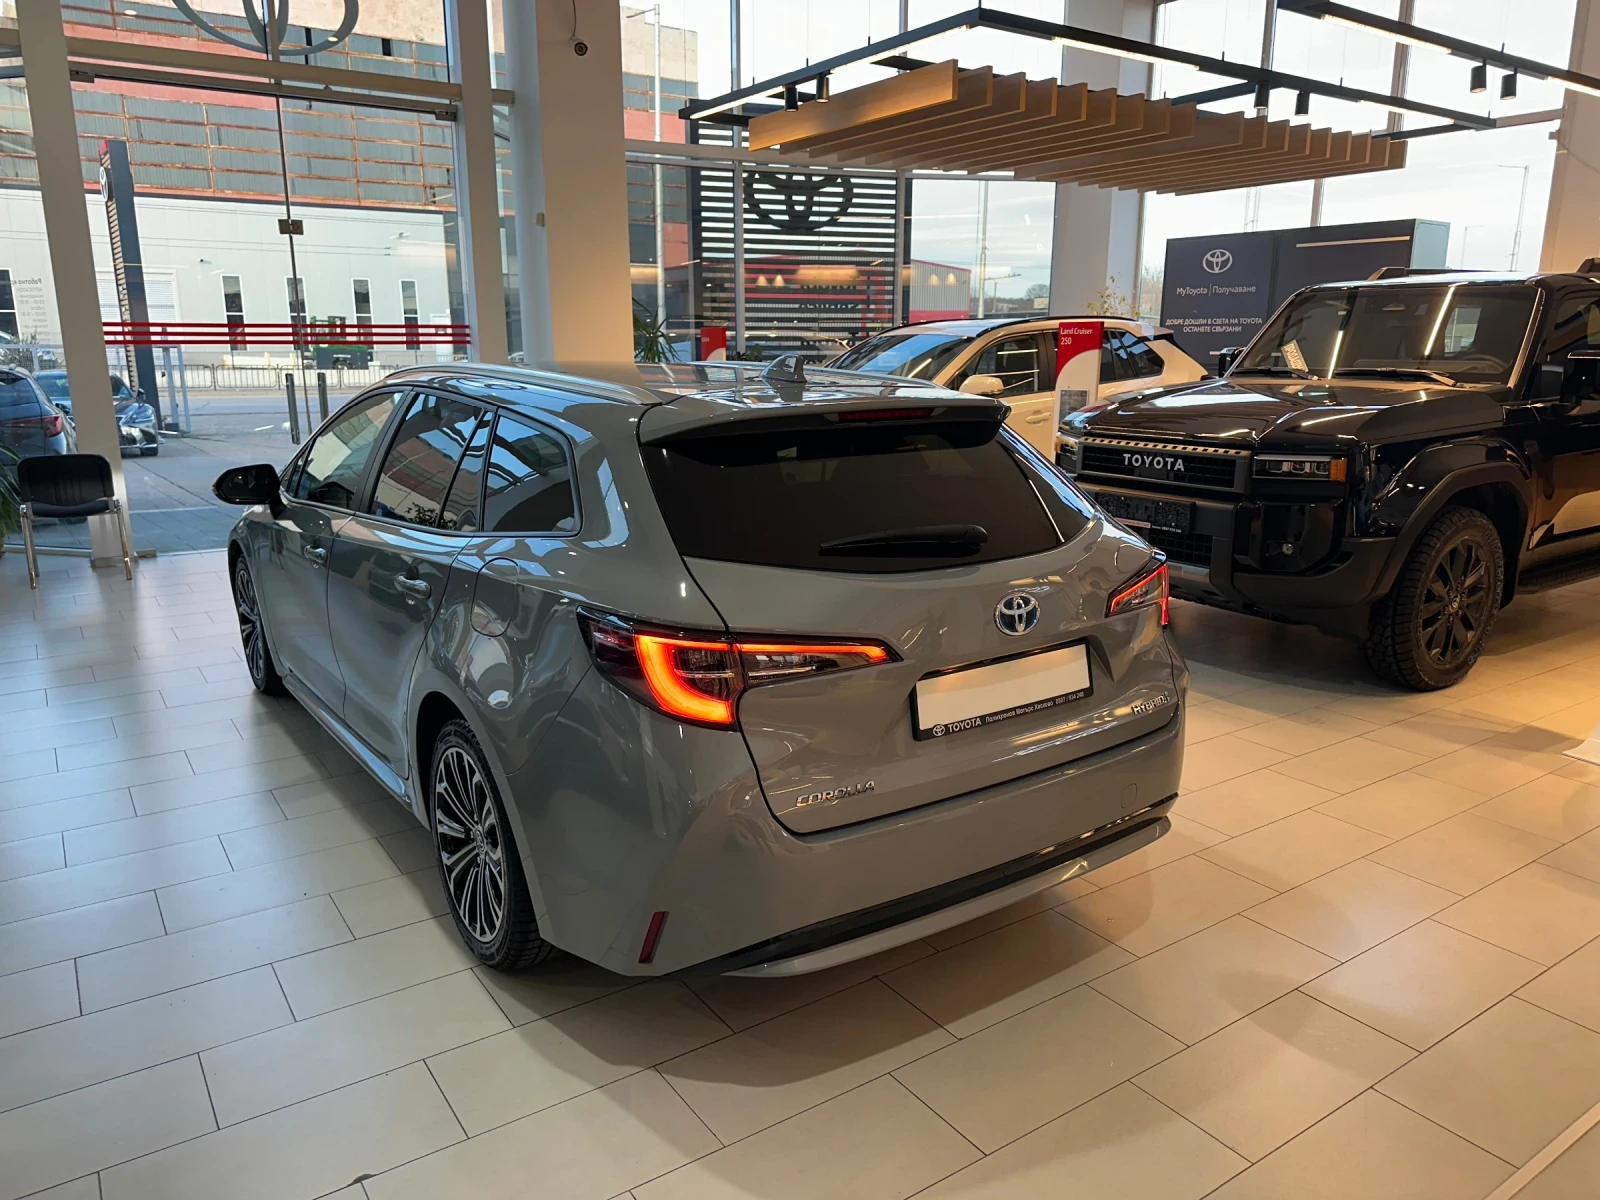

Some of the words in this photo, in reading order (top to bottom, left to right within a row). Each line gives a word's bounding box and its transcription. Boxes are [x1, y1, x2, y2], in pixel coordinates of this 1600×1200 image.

[1176, 286, 1208, 296] MyToyota
[1212, 285, 1257, 295] Получаване
[1165, 318, 1184, 326] ДОБРЕ
[1239, 317, 1262, 325] TOYOTA
[1060, 327, 1073, 335] Land
[1073, 327, 1092, 335] Cruiser
[1211, 325, 1241, 333] СВЪРЗАНИ
[1060, 337, 1072, 345] 250
[1123, 453, 1184, 472] TOYOTA
[1131, 691, 1170, 715] HYBRID
[947, 717, 982, 733] TOYOTA
[985, 710, 1016, 724] Полихронов
[1016, 705, 1034, 718] Мотърс
[796, 780, 875, 807] COROLLA
